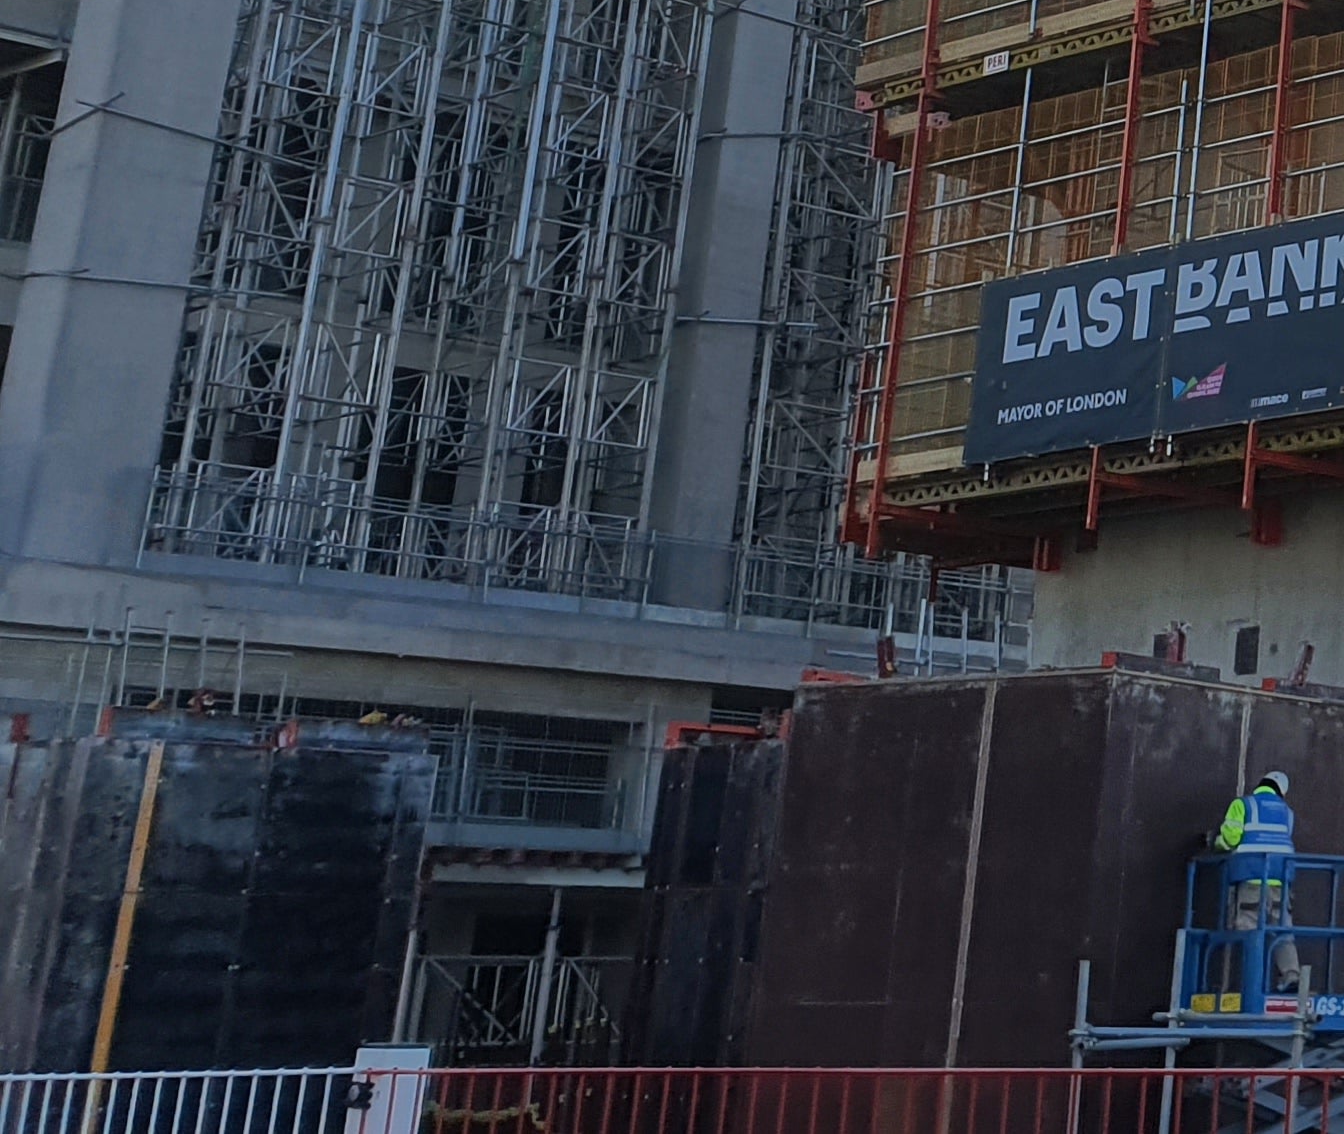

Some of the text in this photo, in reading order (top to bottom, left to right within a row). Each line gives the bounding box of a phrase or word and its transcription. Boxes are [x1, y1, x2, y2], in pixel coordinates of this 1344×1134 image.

[987, 54, 1007, 70] PERI
[1002, 268, 1167, 364] EAST
[997, 388, 1127, 425] MAYOR OF LONDON
